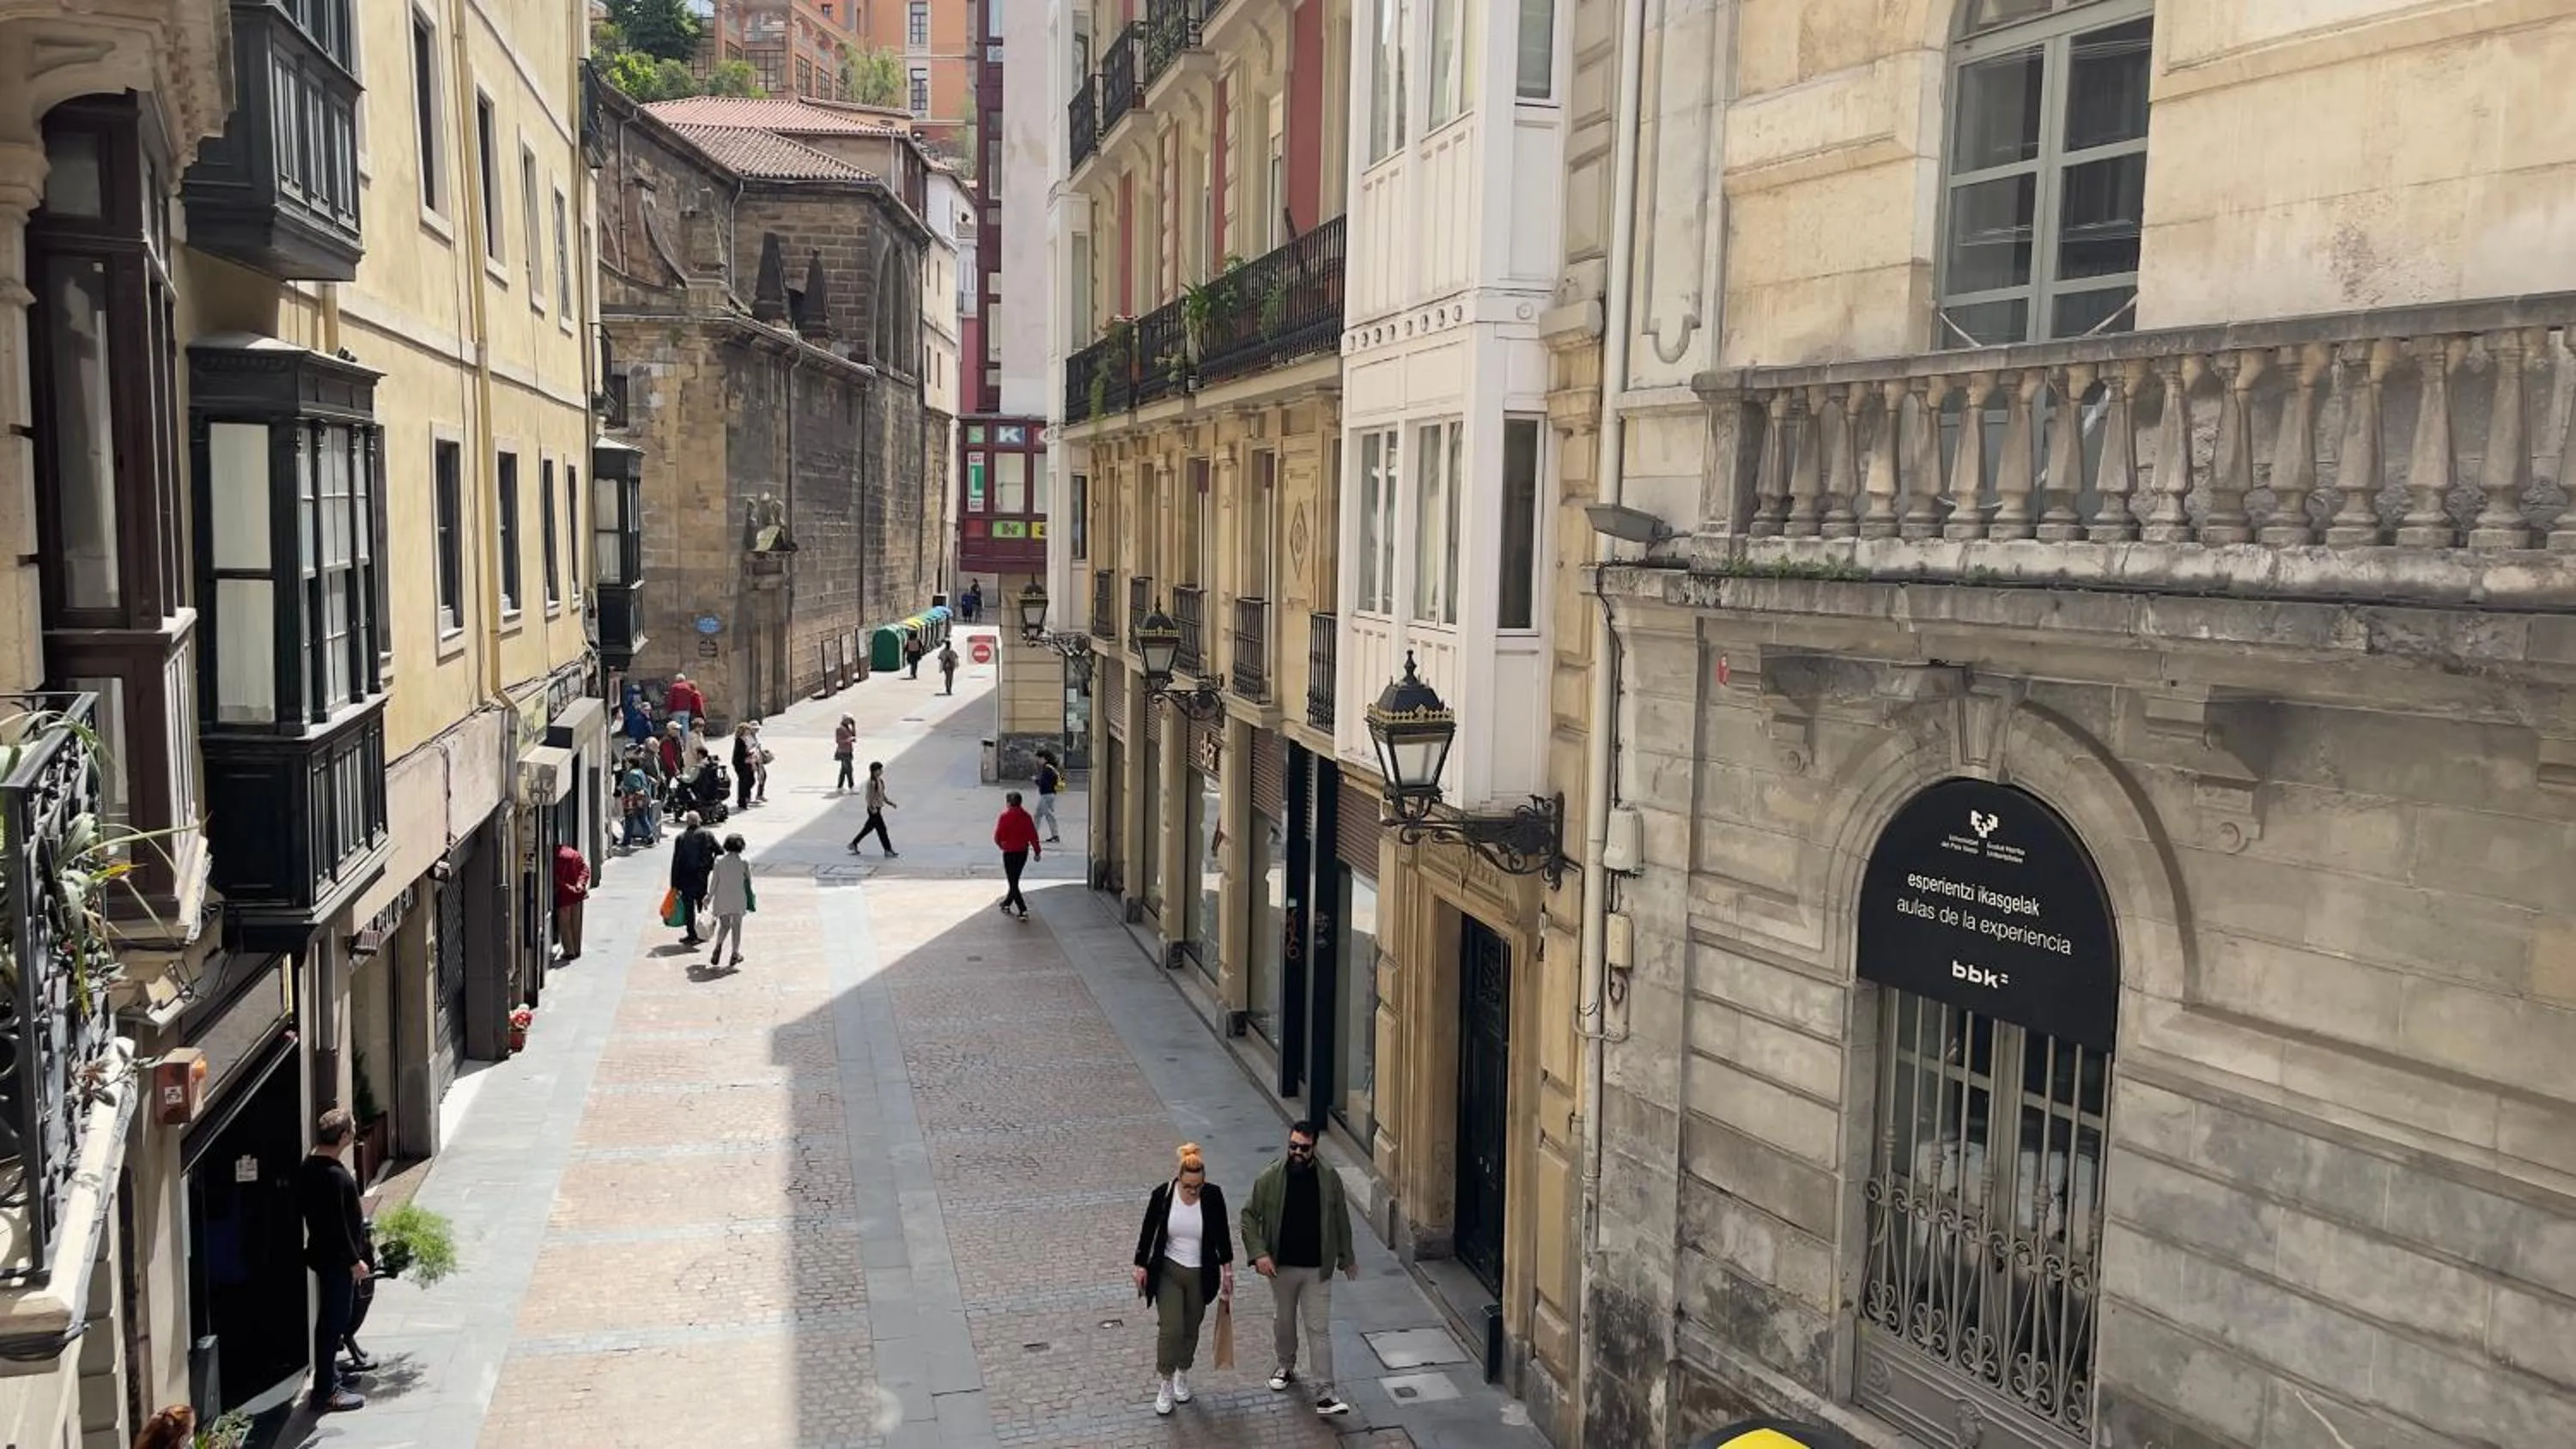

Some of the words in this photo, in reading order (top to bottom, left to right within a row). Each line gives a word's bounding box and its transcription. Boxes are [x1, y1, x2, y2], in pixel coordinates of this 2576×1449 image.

[1907, 872, 1975, 900] esperientzi
[1978, 885, 2040, 917] ikasgelak
[1896, 897, 1935, 919] aulas
[1939, 906, 1959, 926] de
[1962, 910, 1976, 931] la
[1979, 919, 2071, 955] experiencia
